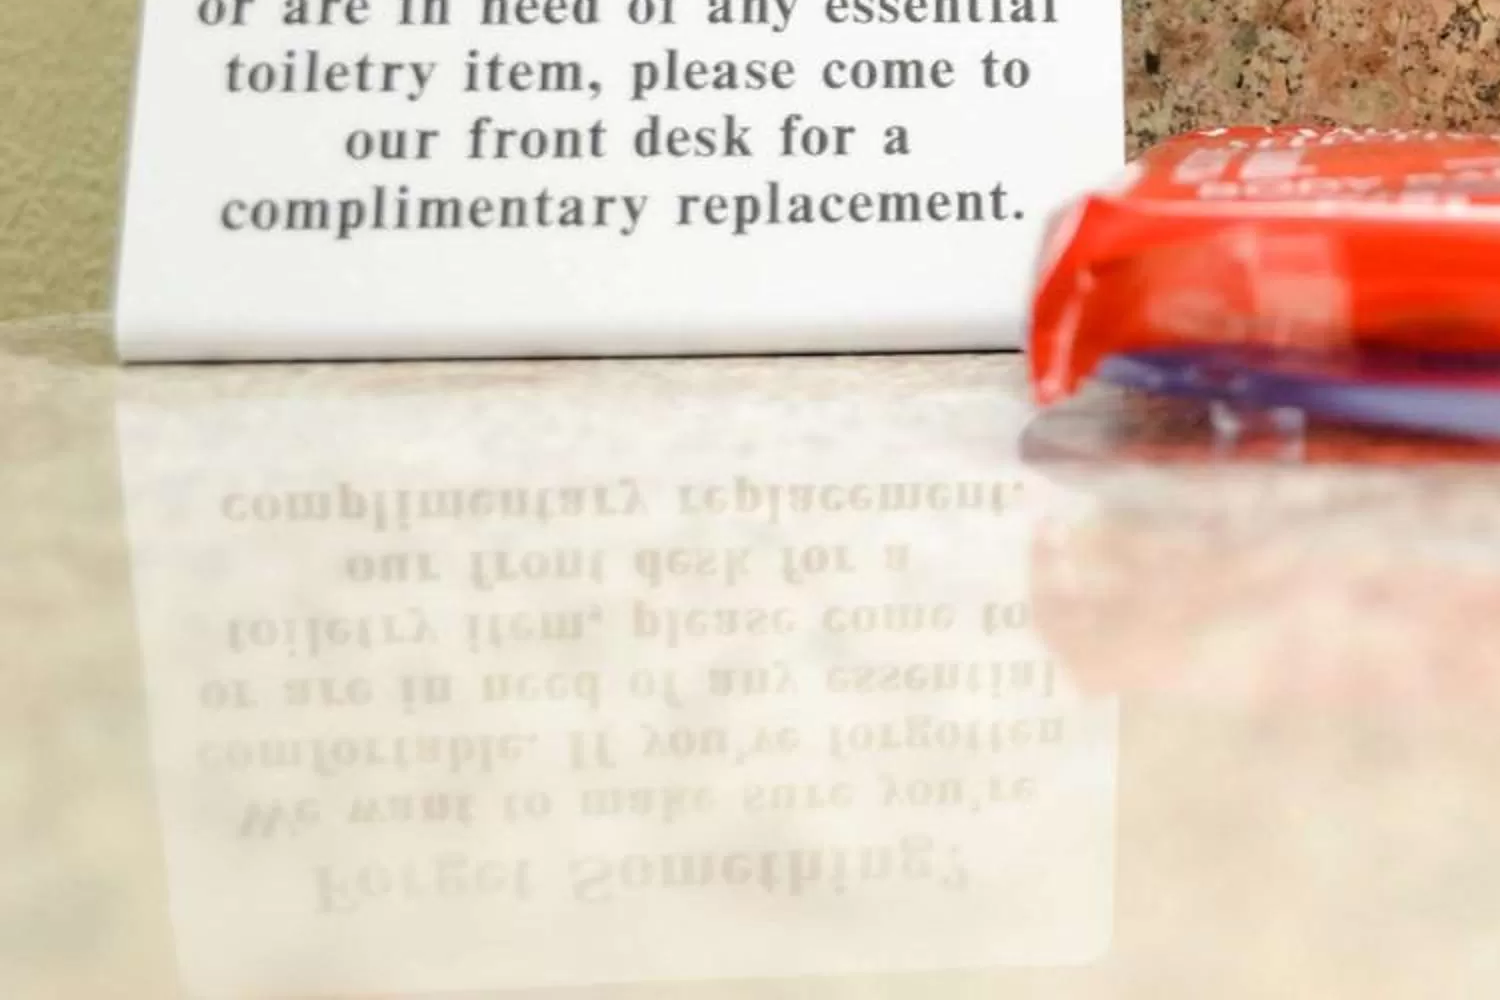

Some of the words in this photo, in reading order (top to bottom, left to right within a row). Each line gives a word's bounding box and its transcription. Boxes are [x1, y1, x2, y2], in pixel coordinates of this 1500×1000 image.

[225, 48, 435, 103] toiletry
[463, 48, 602, 95] item,
[630, 47, 796, 102] please
[821, 58, 955, 90] come
[980, 49, 1031, 90] to
[344, 129, 440, 161] our
[467, 115, 607, 160] front
[633, 113, 752, 159] desk
[778, 112, 857, 157] for
[882, 124, 911, 157] a
[219, 184, 647, 241] complimentary
[676, 180, 1025, 236] replacement.
